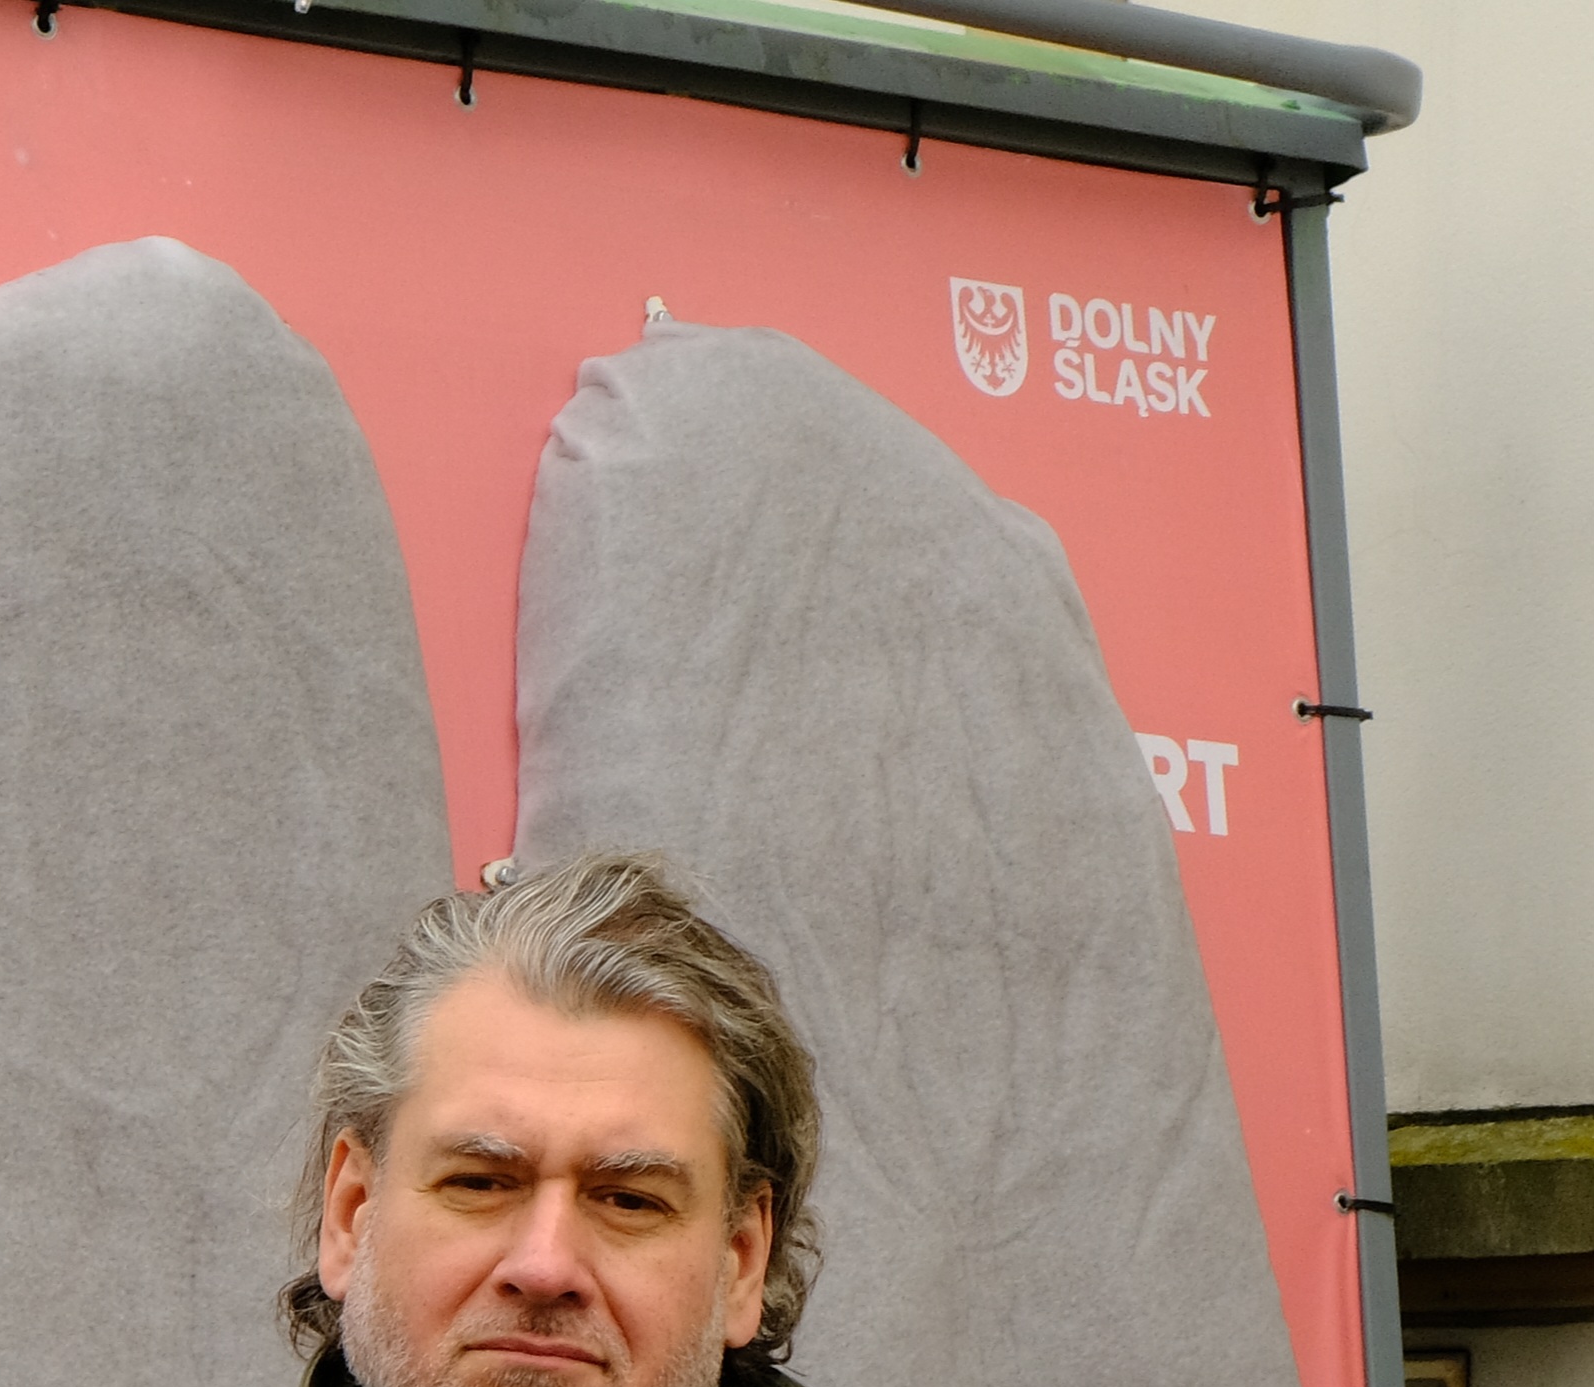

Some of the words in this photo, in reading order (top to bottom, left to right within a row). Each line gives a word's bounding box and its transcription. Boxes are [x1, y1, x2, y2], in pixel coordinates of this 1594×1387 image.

[1049, 292, 1216, 362] DOLNY
[1054, 339, 1212, 418] ŚLĄSK
[1134, 732, 1239, 837] RT
